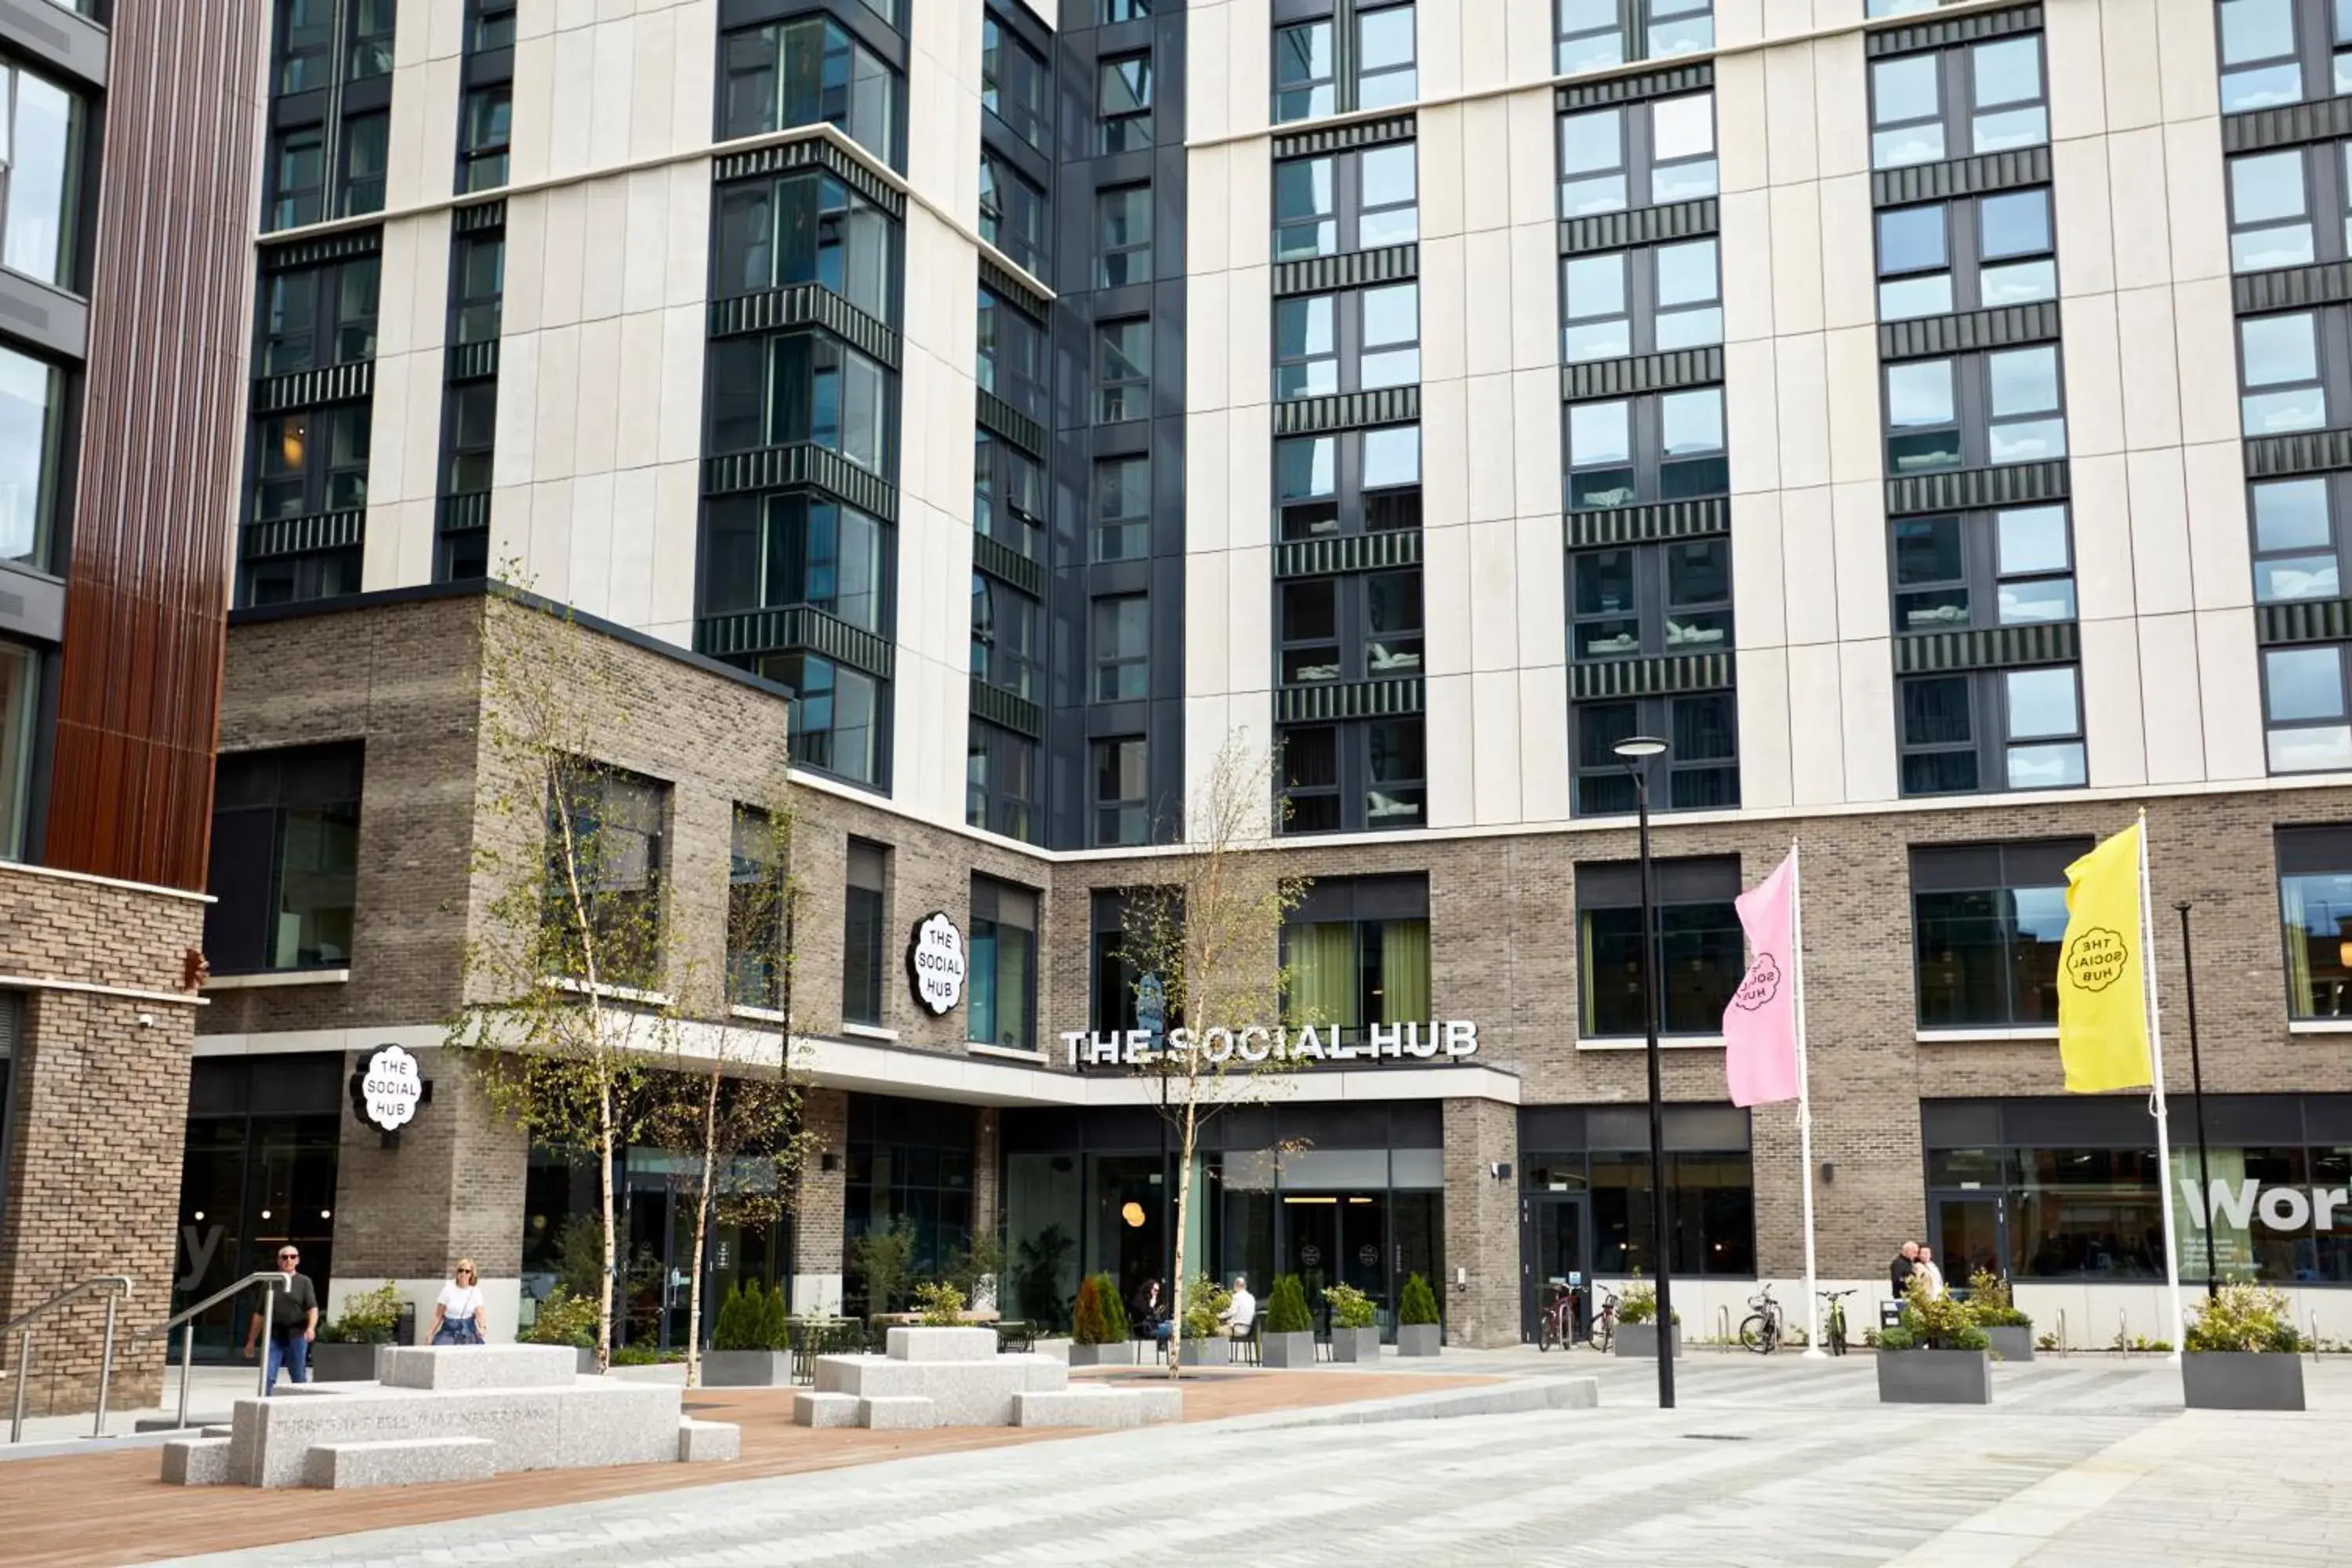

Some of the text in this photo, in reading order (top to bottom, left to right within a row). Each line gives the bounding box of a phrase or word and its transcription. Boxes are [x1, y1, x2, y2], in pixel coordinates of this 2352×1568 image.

[929, 929, 953, 949] THE
[918, 952, 961, 975] SOCIAL
[927, 978, 953, 996] HUB
[1059, 1020, 1478, 1065] THE SOCIAL HUB
[380, 1060, 408, 1075] THE
[367, 1080, 416, 1096] SOCIAL
[376, 1101, 405, 1116] HUB
[2178, 1176, 2352, 1231] Wor
